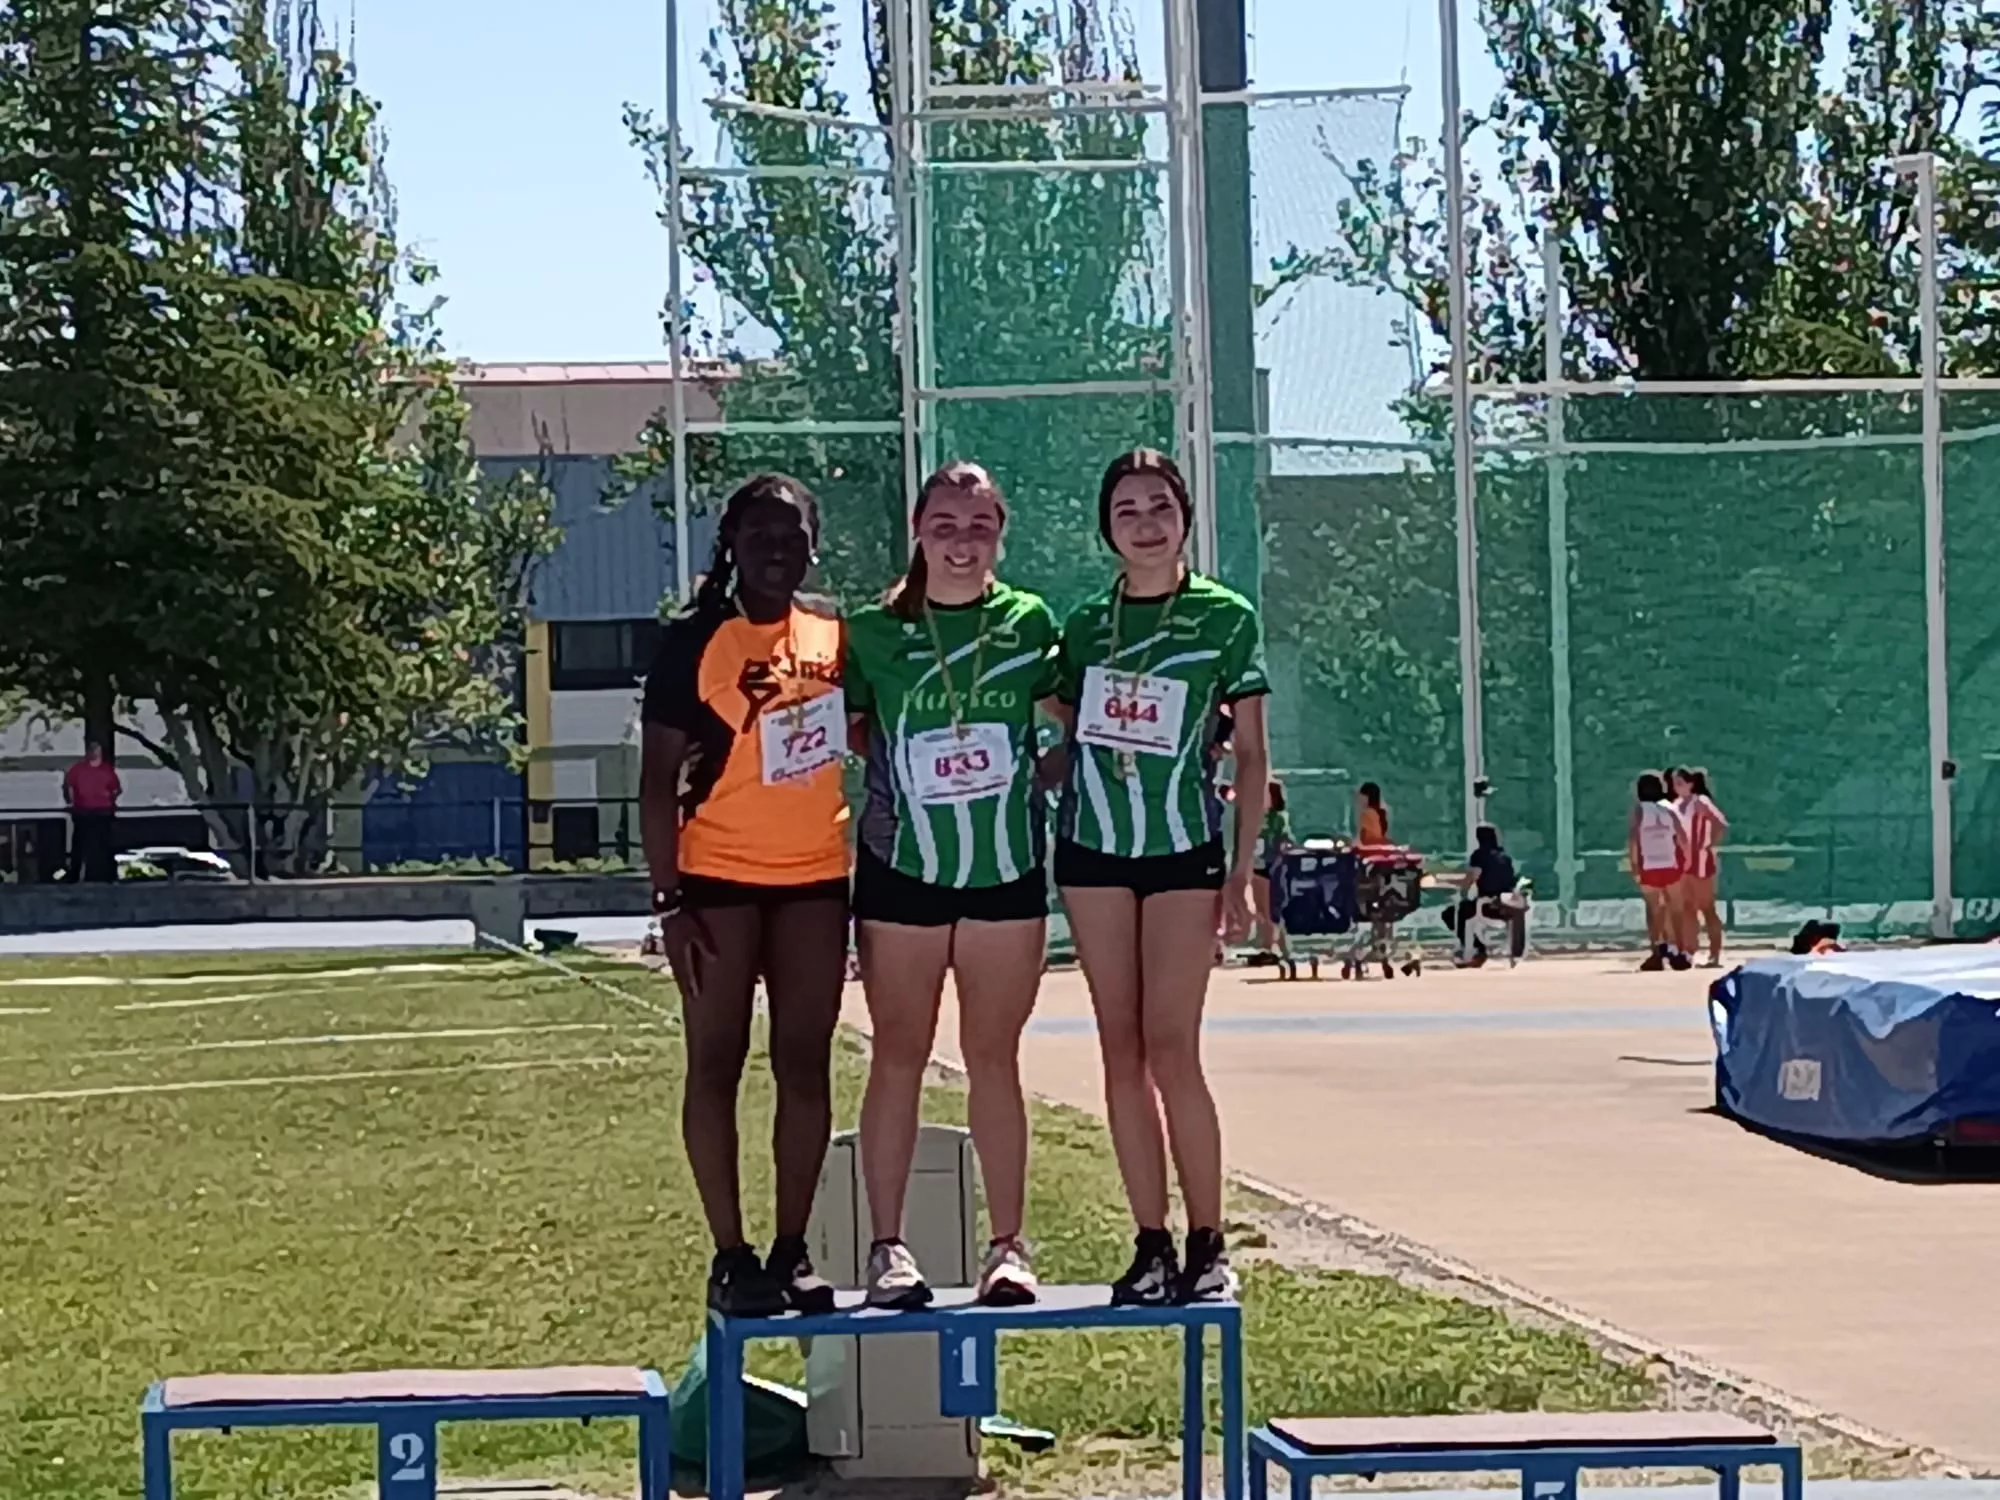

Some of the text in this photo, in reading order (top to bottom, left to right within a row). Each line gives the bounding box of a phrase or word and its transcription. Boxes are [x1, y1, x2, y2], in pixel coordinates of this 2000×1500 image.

[782, 726, 827, 758] 722
[952, 1336, 980, 1386] 1
[389, 1432, 426, 1481] 2
